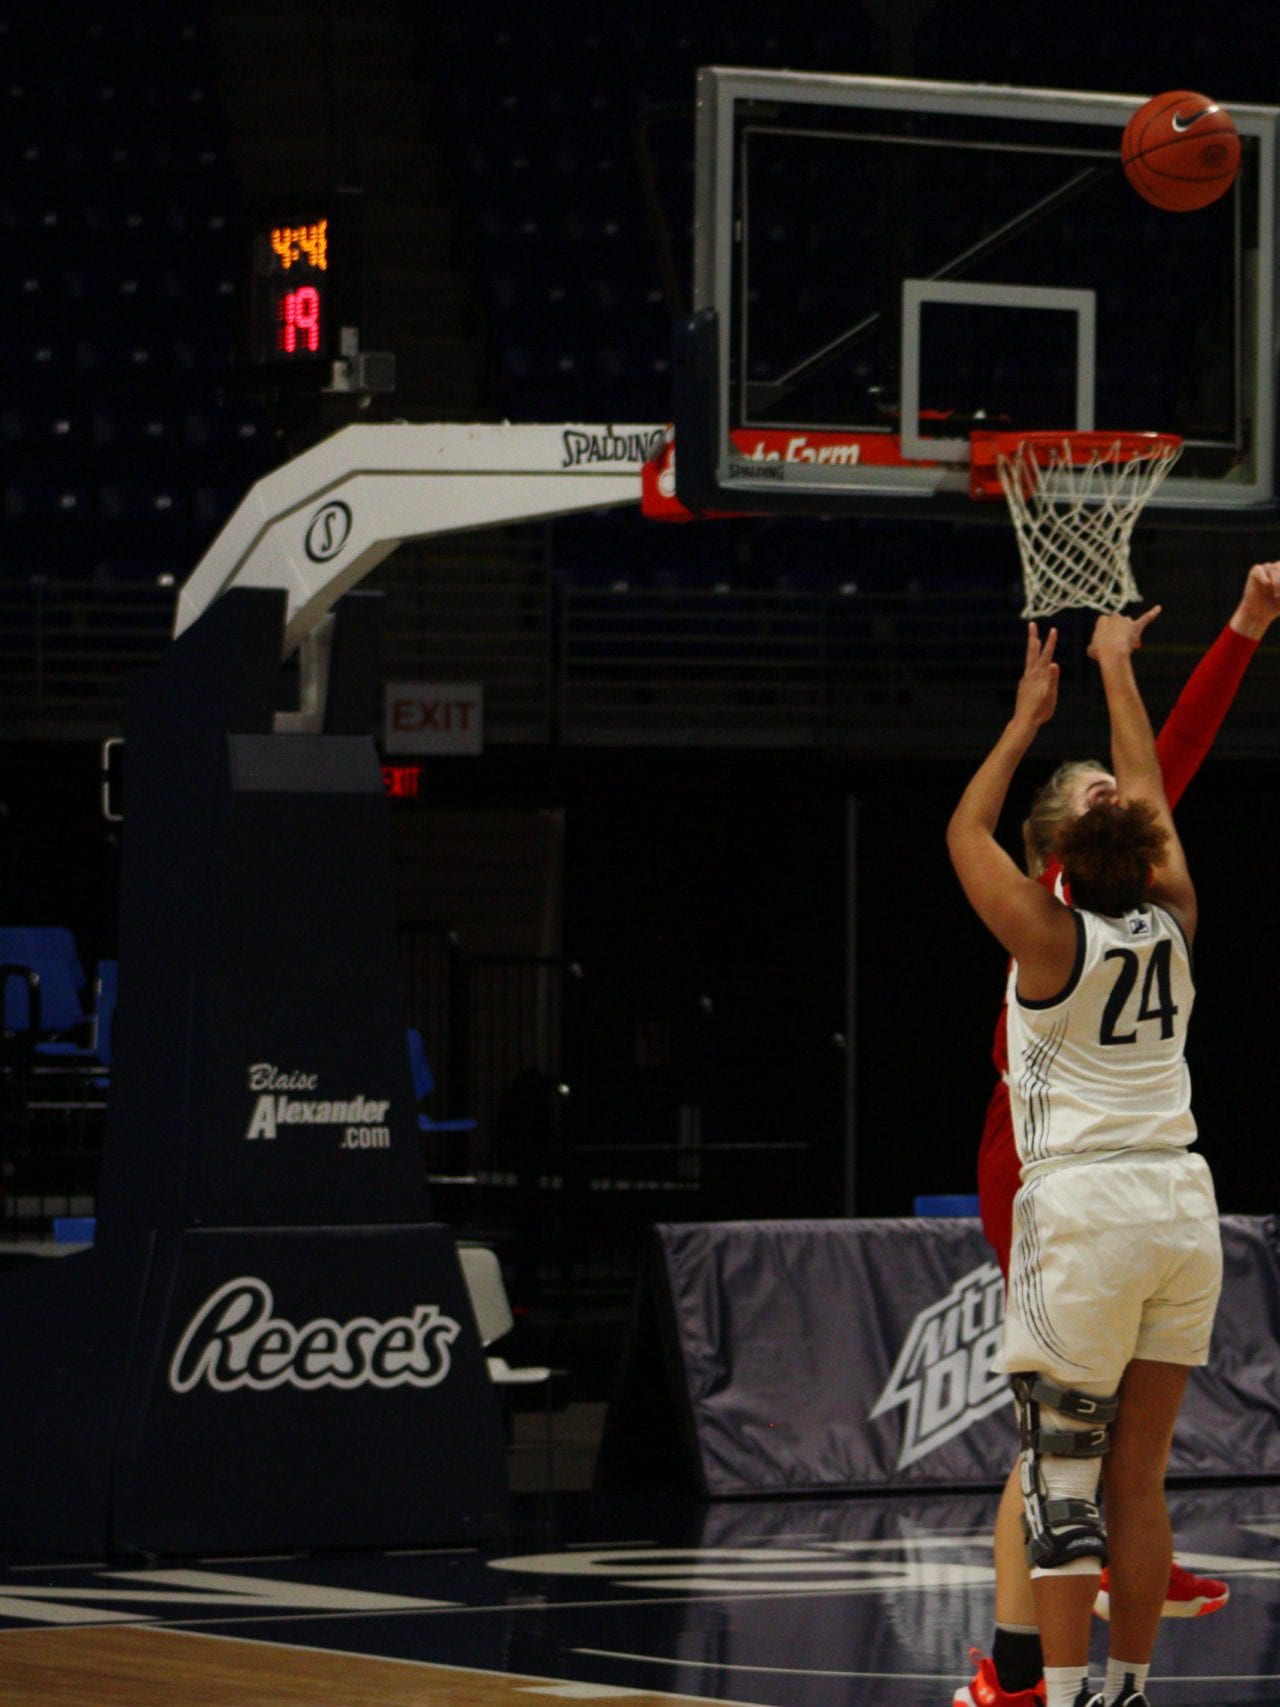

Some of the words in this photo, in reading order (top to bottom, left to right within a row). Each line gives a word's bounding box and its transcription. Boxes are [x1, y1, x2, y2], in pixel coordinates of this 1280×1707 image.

[285, 285, 320, 352] 19
[391, 700, 476, 733] EXIT
[1099, 939, 1178, 1045] 24
[248, 1062, 319, 1091] Blaise
[245, 1093, 391, 1140] Alexander
[339, 1125, 391, 1149] .com
[168, 1276, 463, 1394] Reese's
